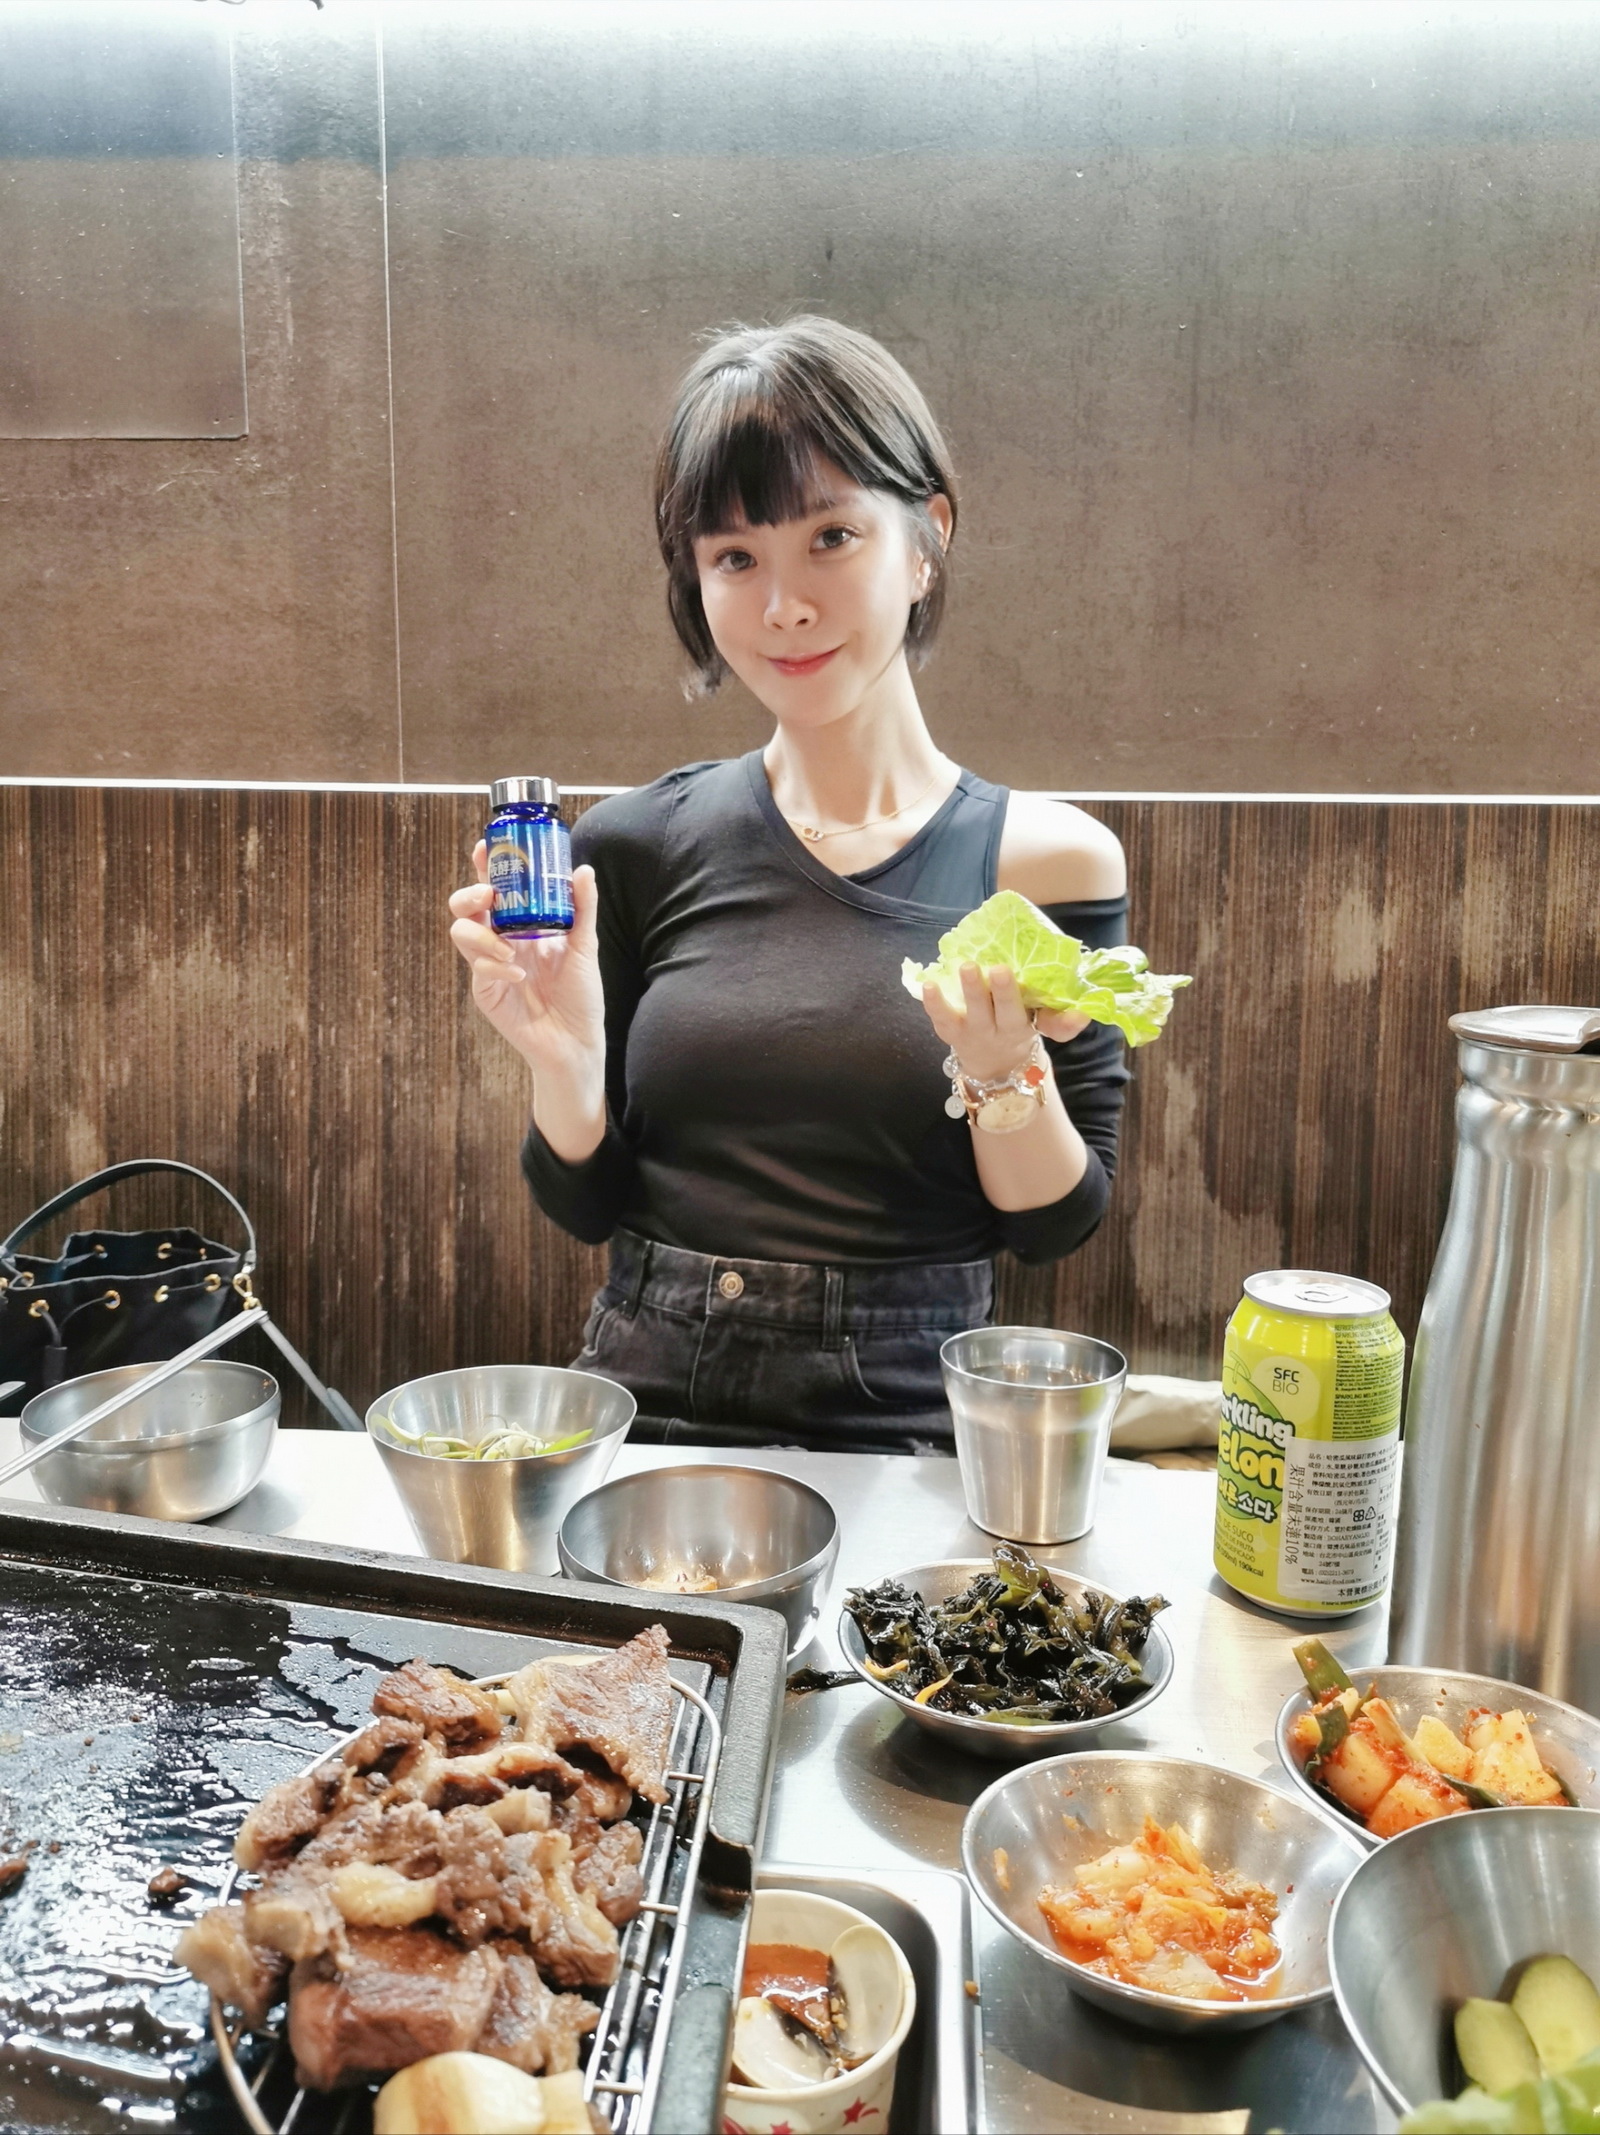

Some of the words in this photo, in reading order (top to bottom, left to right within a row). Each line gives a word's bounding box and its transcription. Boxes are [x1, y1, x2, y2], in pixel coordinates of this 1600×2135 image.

[1273, 1367, 1300, 1383] SFC
[1272, 1379, 1300, 1396] BIO
[1232, 1525, 1254, 1544] SUCO
